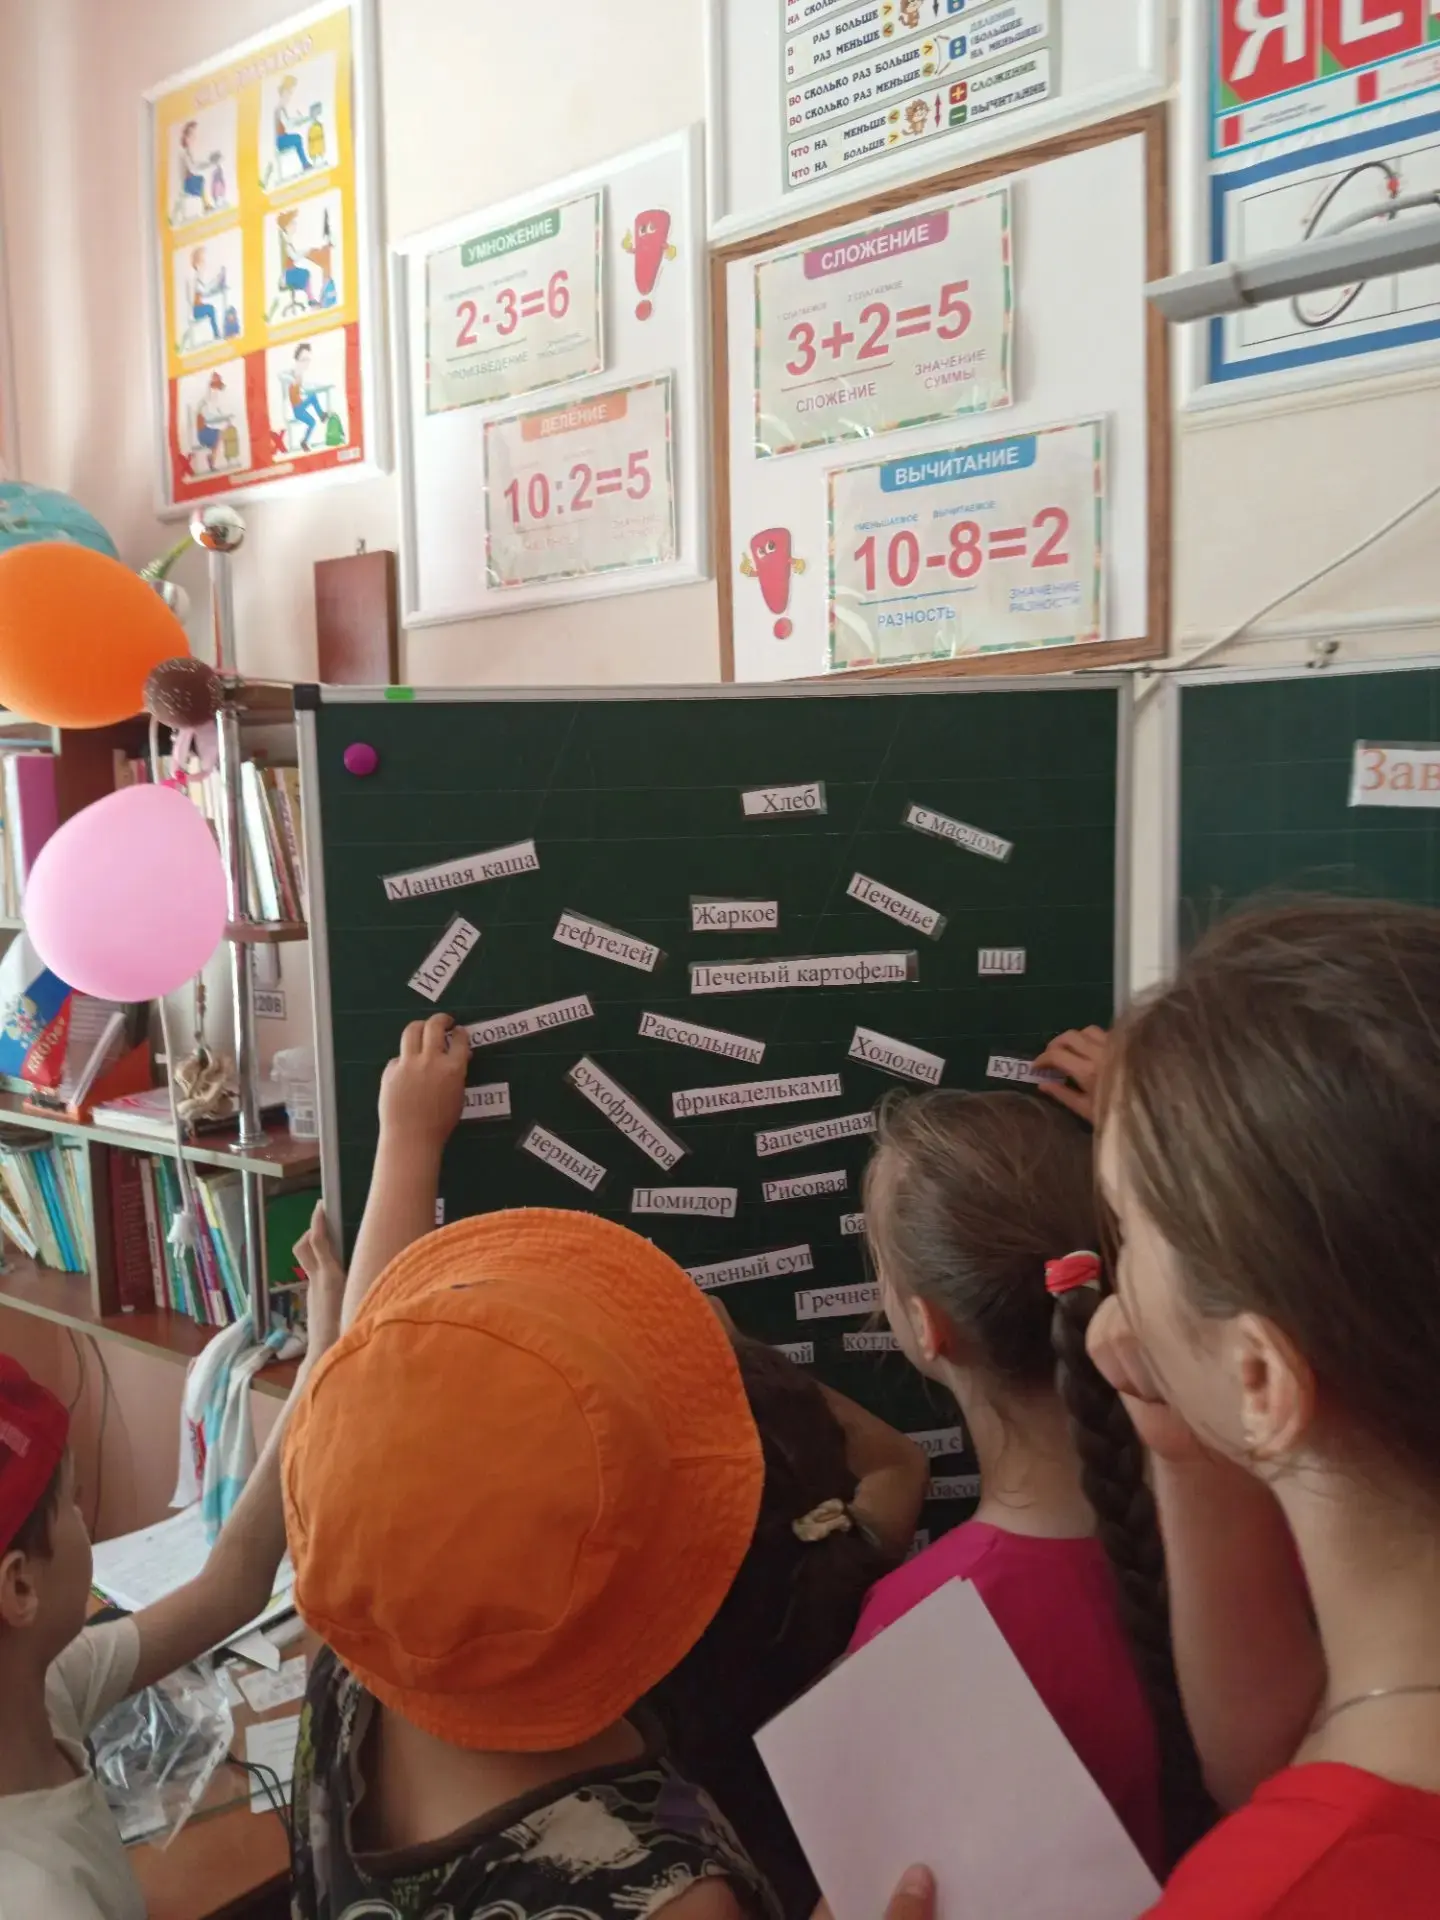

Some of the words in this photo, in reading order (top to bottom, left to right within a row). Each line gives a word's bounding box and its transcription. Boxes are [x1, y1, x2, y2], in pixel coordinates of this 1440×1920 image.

[788, 13, 800, 26] НА
[804, 0, 837, 16] СКОЛЬ
[788, 47, 794, 56] В
[812, 30, 831, 44] РАЗ
[835, 9, 879, 35] БОЛЬШЕ
[788, 66, 794, 75] В
[813, 49, 832, 64] РАЗ
[836, 30, 880, 55] МЕНЬШЕ
[789, 95, 801, 107] ВО
[804, 76, 849, 100] СКОЛЬКО
[852, 67, 871, 82] РАЗ
[875, 49, 920, 74] БОЛЬШЕ
[970, 60, 1036, 92] СЛОЖЕНИЕ
[789, 115, 802, 127] ВО
[805, 97, 849, 120] СКОЛЬКО
[853, 88, 872, 103] РАЗ
[876, 69, 921, 95] МЕНЬШЕ
[971, 81, 1046, 116] ВЫЧИТАНИЕ
[791, 145, 810, 158] ЧТО
[814, 139, 828, 151] НА
[843, 116, 886, 140] МЕНЬШЕ
[791, 167, 810, 179] ЧТО
[814, 161, 828, 172] НА
[843, 138, 885, 161] БОЛЬШЕ
[468, 218, 553, 261] УМНОЖЕНИЕ
[821, 224, 930, 271] СЛОЖЕНИЕ
[785, 280, 972, 376] 3+2=5
[914, 350, 986, 376] ЗНАЧЕНИЕ
[924, 368, 976, 390] СУММЫ
[796, 382, 877, 413] СЛОЖЕНИЕ
[541, 404, 607, 435] ДЕЛЕНИЕ
[895, 446, 1020, 486] ВЫЧИТАНИЕ
[854, 506, 1069, 591] 10-8=2
[878, 607, 956, 628] РАЗНОСТЬ
[762, 788, 816, 813] Хлеб
[915, 811, 927, 824] с
[930, 817, 1004, 856] маслом
[388, 867, 475, 900] Манная
[481, 852, 537, 880] каша
[695, 906, 776, 929] Жаркое
[851, 876, 933, 928] Печенье
[409, 923, 474, 994] Йогурт
[558, 921, 655, 966] тефтелей
[694, 965, 790, 987] Печеный
[797, 961, 905, 986] картофель
[445, 1018, 530, 1050] совая
[536, 1001, 589, 1028] каша
[641, 1016, 761, 1064] Рассольник
[853, 1036, 940, 1083] Холодец
[574, 1064, 676, 1168] сухофруктов
[676, 1077, 840, 1115] фрикадельками
[758, 1113, 874, 1152] Запеченная
[531, 1132, 600, 1186] черный
[636, 1189, 733, 1215] Помидор
[765, 1178, 847, 1200] Рисовая
[685, 1256, 770, 1287] еленый
[776, 1252, 812, 1273] суп
